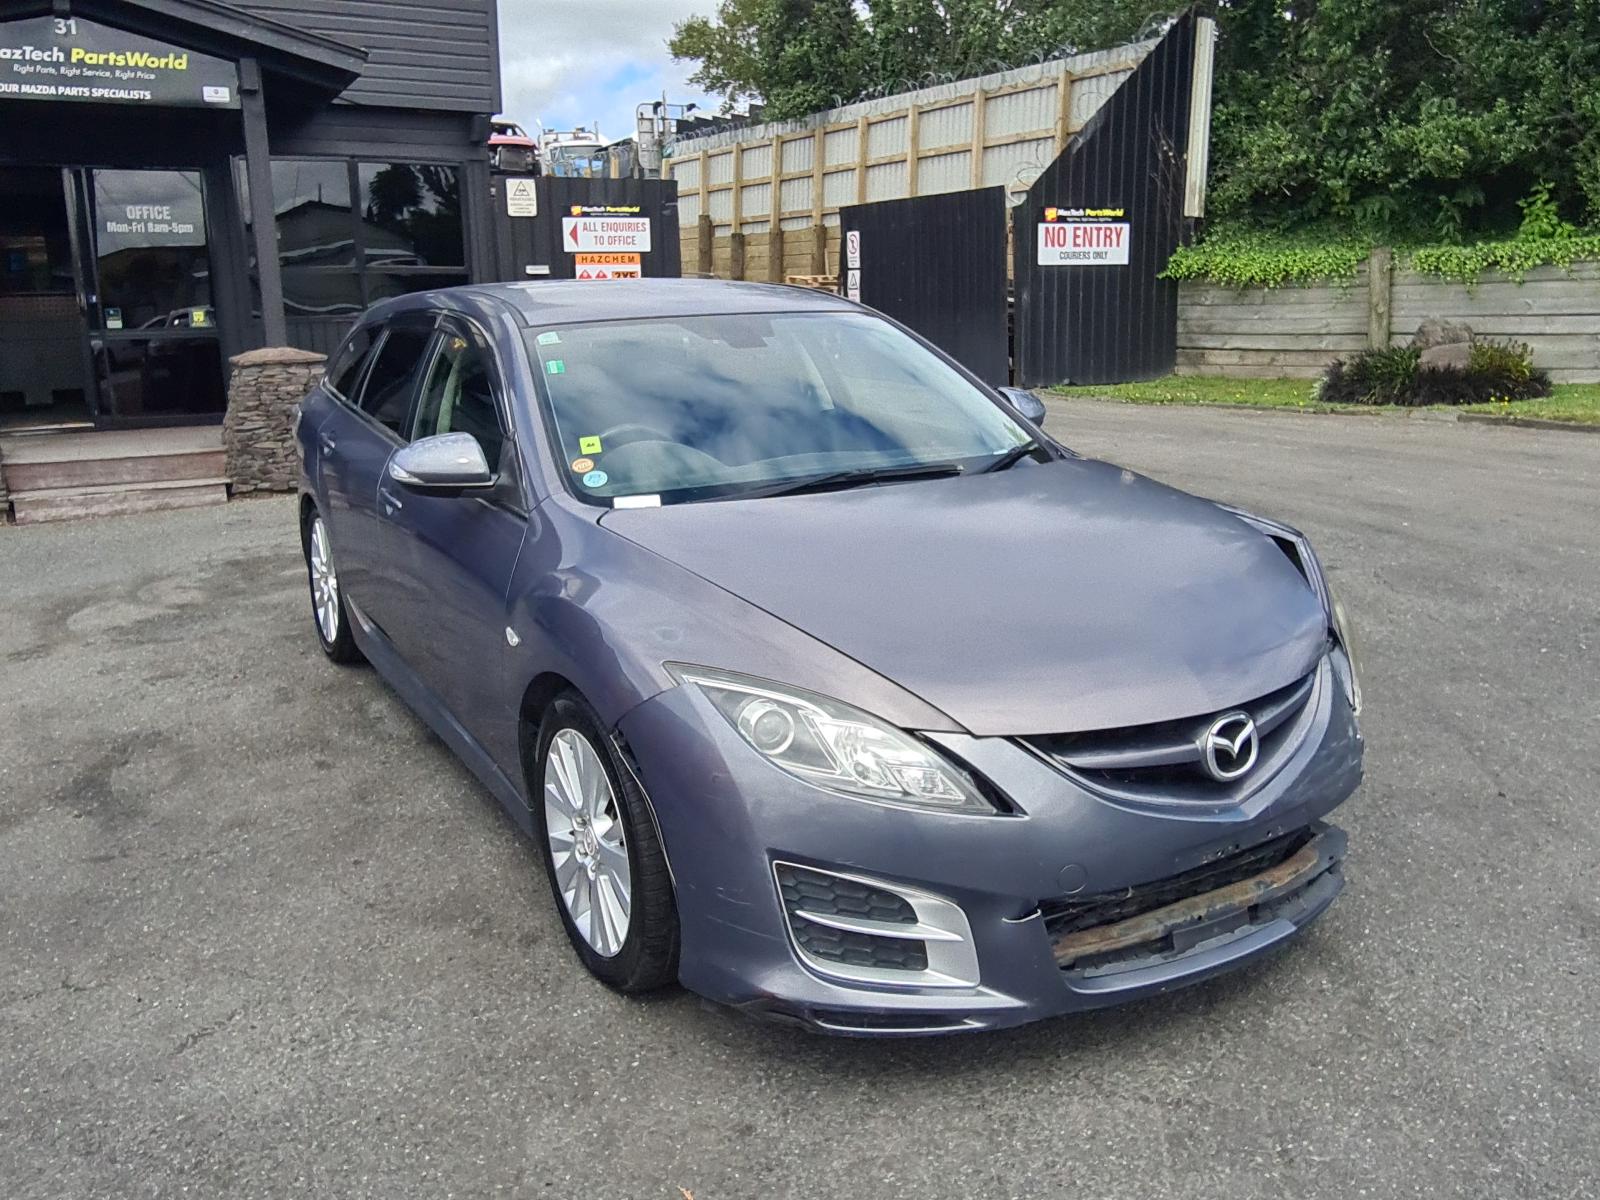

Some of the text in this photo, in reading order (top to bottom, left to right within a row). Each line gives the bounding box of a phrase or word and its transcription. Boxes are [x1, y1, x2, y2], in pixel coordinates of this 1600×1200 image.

[54, 18, 77, 35] 31
[0, 46, 188, 70] azTech PartsWorld
[13, 63, 156, 80] Right Parts, Right Service, Right Price
[0, 83, 152, 100] OUR MAZDA PARTS SPECIALISTS
[126, 206, 171, 220] OFFICE
[106, 221, 194, 234] Mon-Fri 8am-5pm
[582, 222, 647, 233] ALL ENQUIRIES
[594, 235, 637, 246] TO OFFICE
[1044, 226, 1123, 248] NO ENTRY
[581, 255, 636, 264] HAZCHEM
[1059, 251, 1108, 260] COURIERS ONLY
